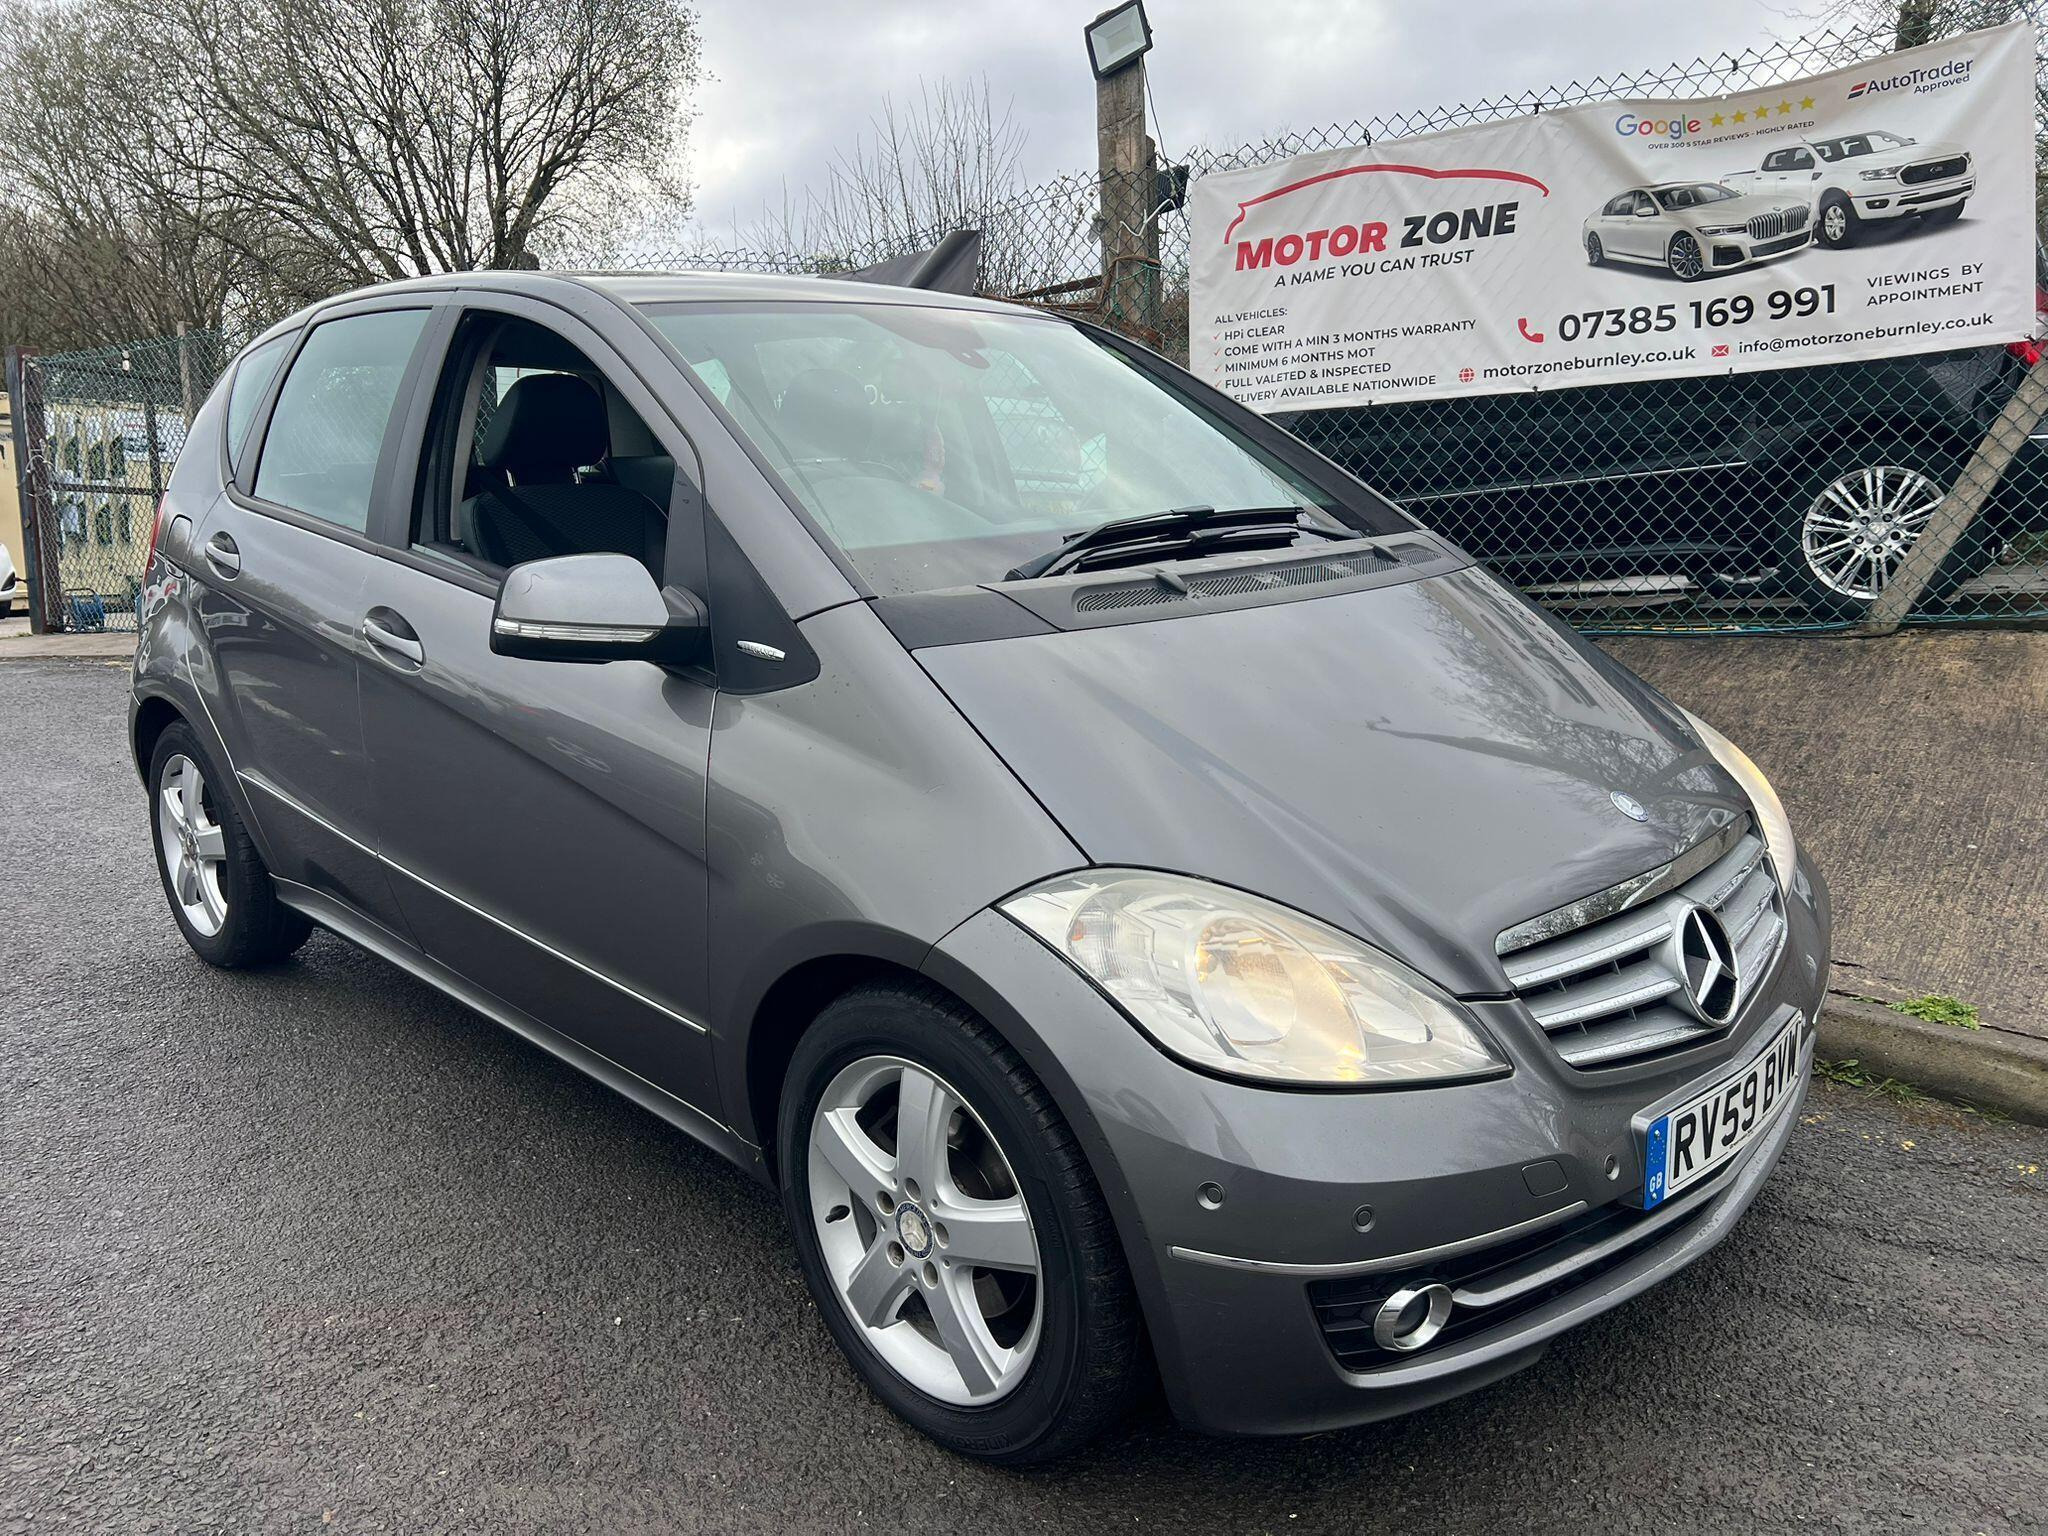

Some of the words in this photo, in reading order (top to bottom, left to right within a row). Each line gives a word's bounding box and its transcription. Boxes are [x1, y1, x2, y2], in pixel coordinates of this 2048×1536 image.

[1866, 59, 1974, 95] AutoTrader
[1913, 74, 1970, 94] Approved
[1615, 113, 1701, 140] Google
[1670, 141, 1685, 149] 300
[1692, 139, 1712, 147] STAR
[1713, 131, 1750, 144] REVIEWS
[1755, 124, 1786, 136] HIGHLY
[1787, 120, 1815, 130] RATED
[1235, 221, 1388, 272] MOTOR
[1400, 201, 1519, 249] ZONE
[1274, 275, 1286, 288] A
[1290, 266, 1336, 286] NAME
[1340, 261, 1376, 278] YOU
[1380, 257, 1415, 273] CAN
[1420, 249, 1475, 268] TRUST
[1867, 267, 1950, 288] VIEWINGS
[1961, 262, 1984, 276] BY
[1866, 281, 1984, 307] APPOINTMENT
[1214, 315, 1233, 324] ALL
[1235, 307, 1288, 321] VEHICLES:
[1558, 303, 1677, 342] 07385
[1689, 295, 1755, 329] 169
[1767, 284, 1836, 320] 991
[1224, 328, 1244, 341] HPi
[1247, 325, 1285, 338] CLEAR
[1224, 344, 1259, 357] COME
[1262, 340, 1292, 352] WITH
[1294, 339, 1303, 348] A
[1306, 334, 1330, 346] MIN
[1333, 334, 1340, 343] 3
[1343, 328, 1398, 343] MONTHS
[1401, 319, 1476, 337] WARRANTY
[1738, 312, 1994, 354] info@motorzoneburnley.co.uk
[1225, 358, 1278, 373] MINIMUM
[1281, 356, 1288, 366] 6
[1291, 350, 1344, 365] MONTHS
[1347, 347, 1375, 359] MOT
[1483, 346, 1697, 379] motorzoneburnley.co.uk
[1225, 377, 1253, 389] FULL
[1255, 370, 1307, 385] VALETED
[1309, 369, 1318, 379] &
[1321, 362, 1391, 378] INSPECTED
[1233, 389, 1279, 403] ELIVERY
[1280, 383, 1350, 398] AVAILABLE
[1353, 375, 1437, 392] NATIONWIDE
[1673, 1071, 1758, 1180] RV59
[1649, 1171, 1663, 1193] GB
